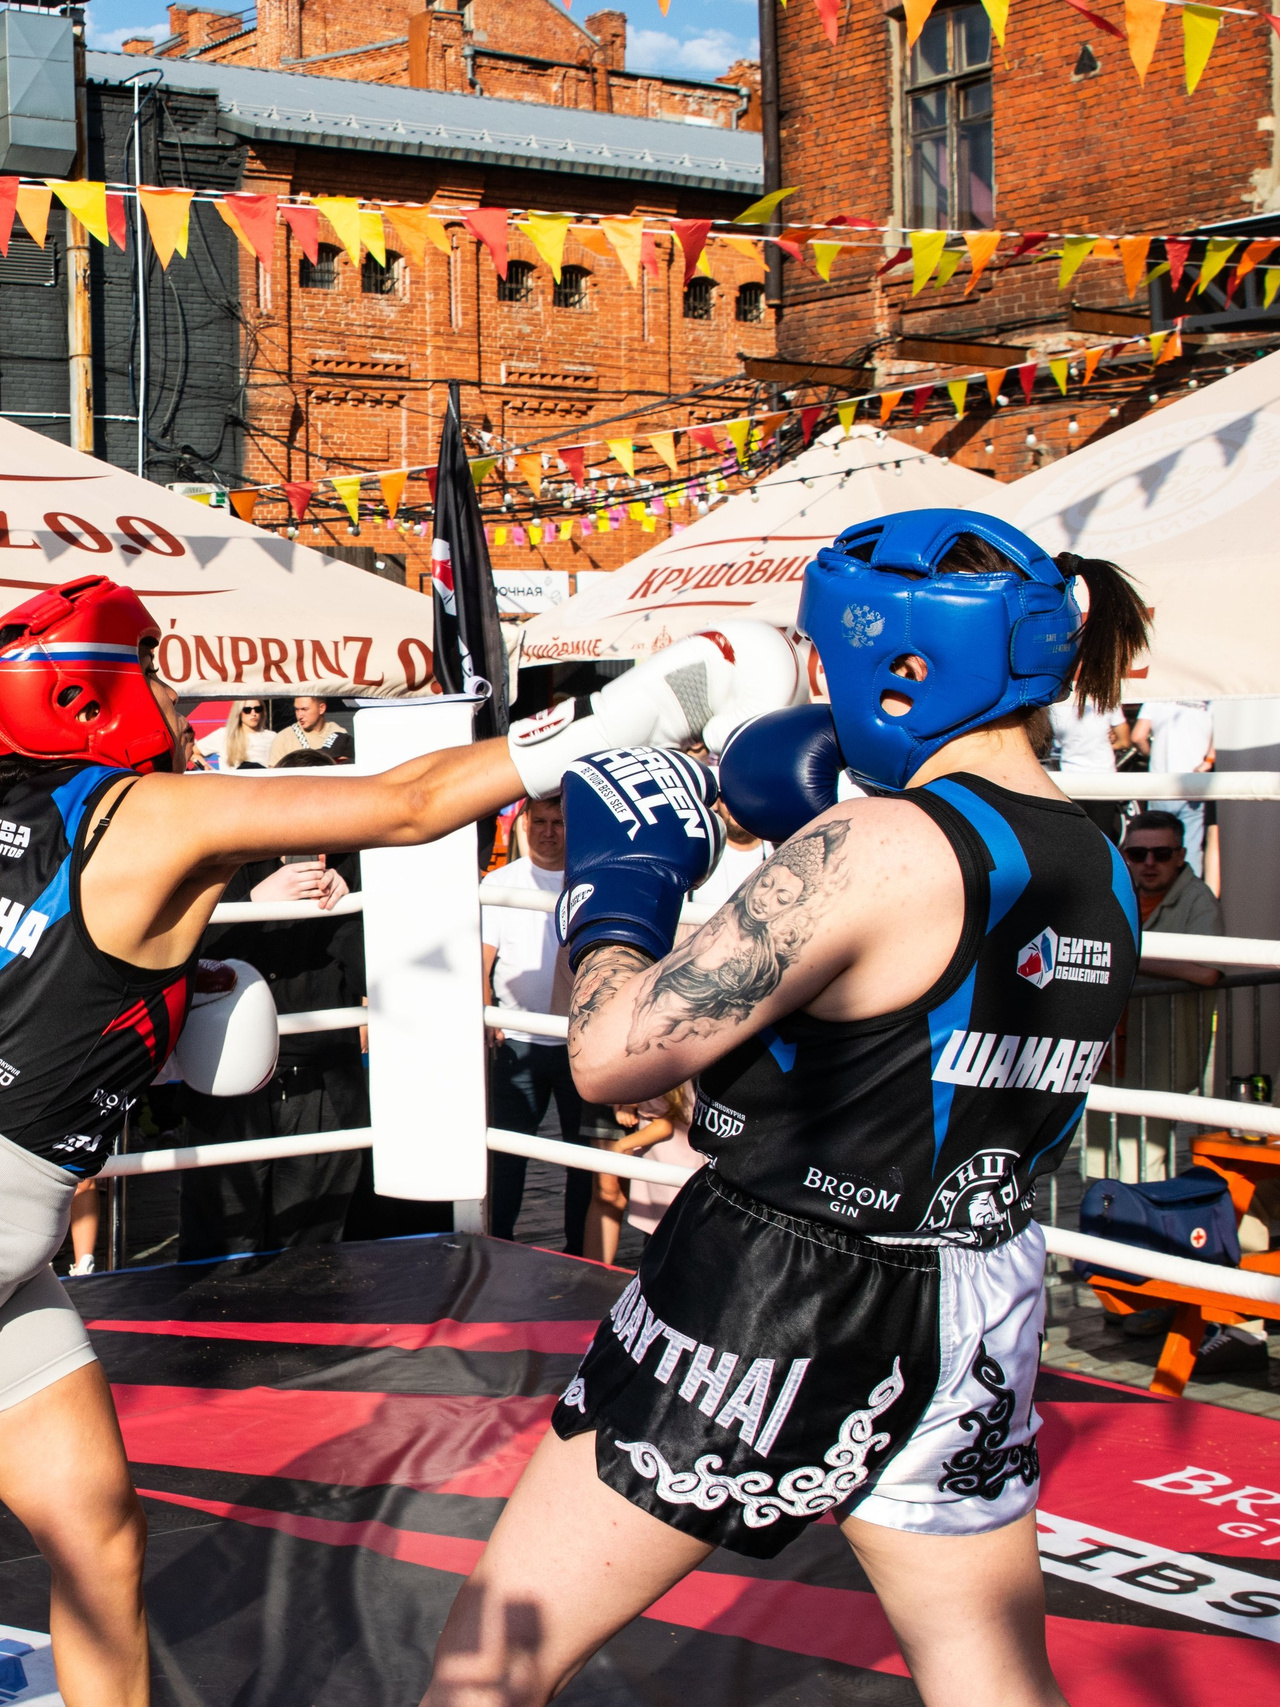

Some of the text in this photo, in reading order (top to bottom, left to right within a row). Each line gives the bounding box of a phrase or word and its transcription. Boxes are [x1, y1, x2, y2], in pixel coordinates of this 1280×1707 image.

[158, 618, 385, 687] ÓNPRINZ
[590, 750, 658, 826] HILL
[598, 784, 616, 800] BEST
[610, 798, 627, 814] SELF
[619, 745, 707, 839] GREEN
[1054, 965, 1110, 985] ОБЩЕПИТОВ
[1057, 936, 1111, 968] БИТВА
[930, 1029, 1110, 1093] ШАМАЕВ
[803, 1166, 902, 1213] BROOM
[829, 1201, 859, 1218] GIN
